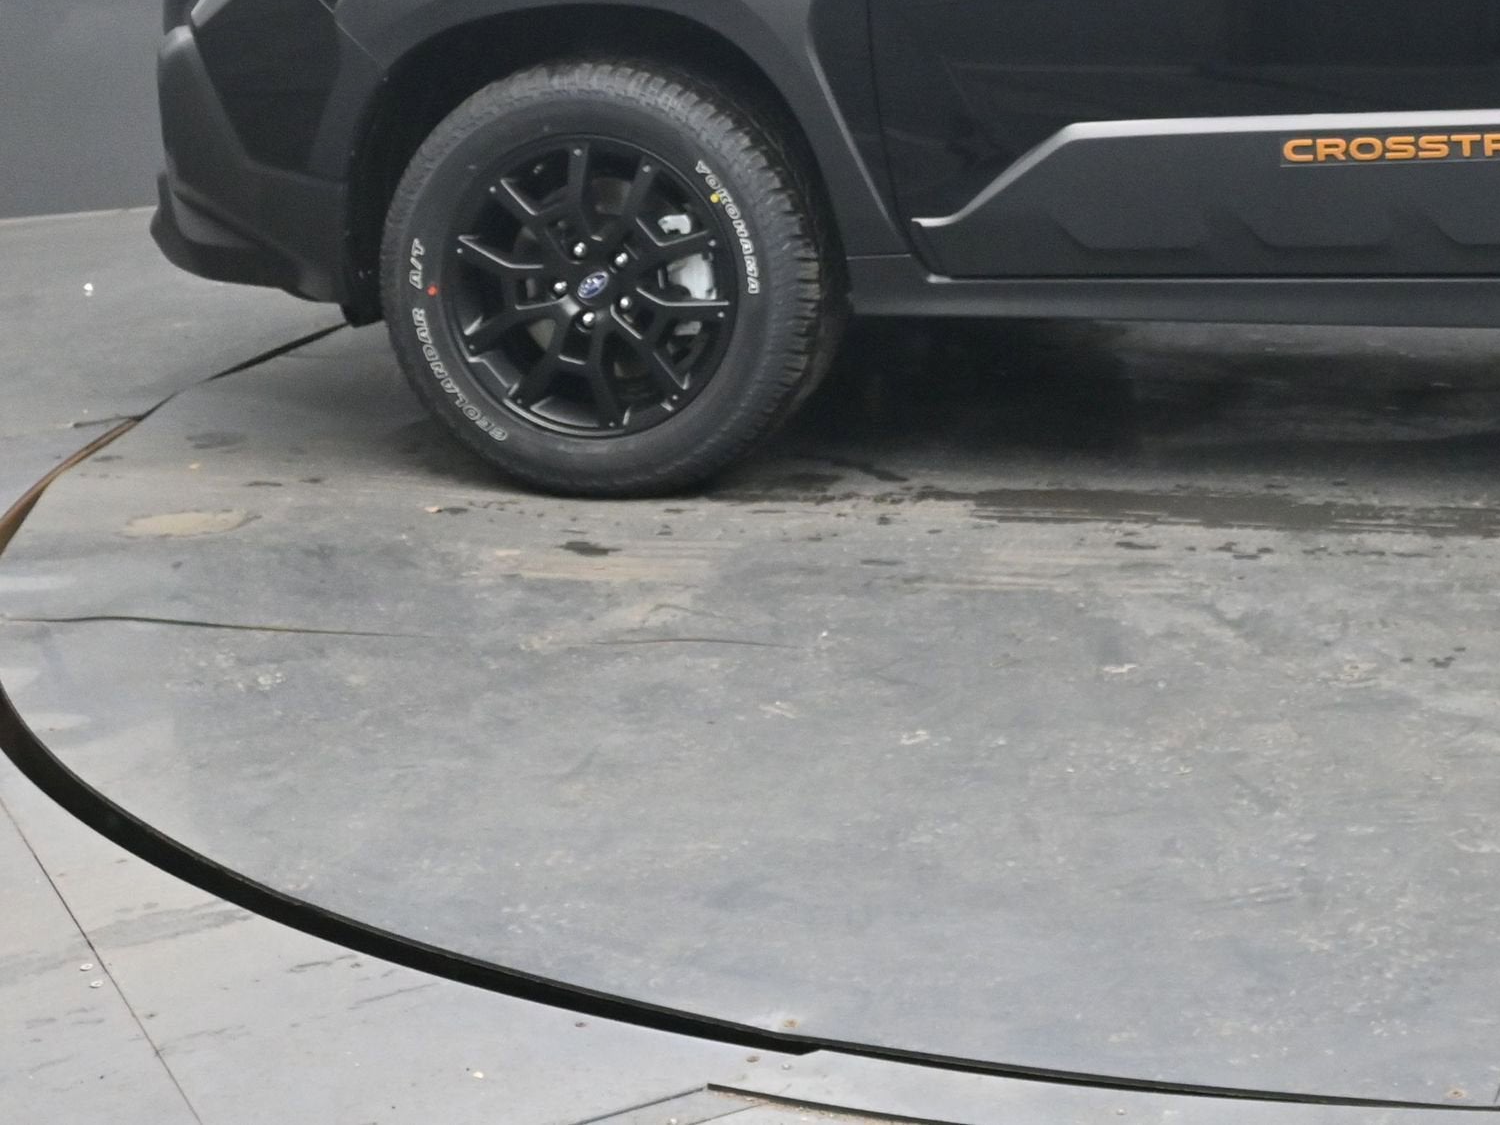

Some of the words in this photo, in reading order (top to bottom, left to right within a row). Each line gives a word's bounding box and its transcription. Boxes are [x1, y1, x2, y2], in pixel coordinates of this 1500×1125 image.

[408, 237, 426, 290] A/T
[695, 159, 760, 294] YOKOHAMA
[411, 307, 508, 441] GEOLANDAR
